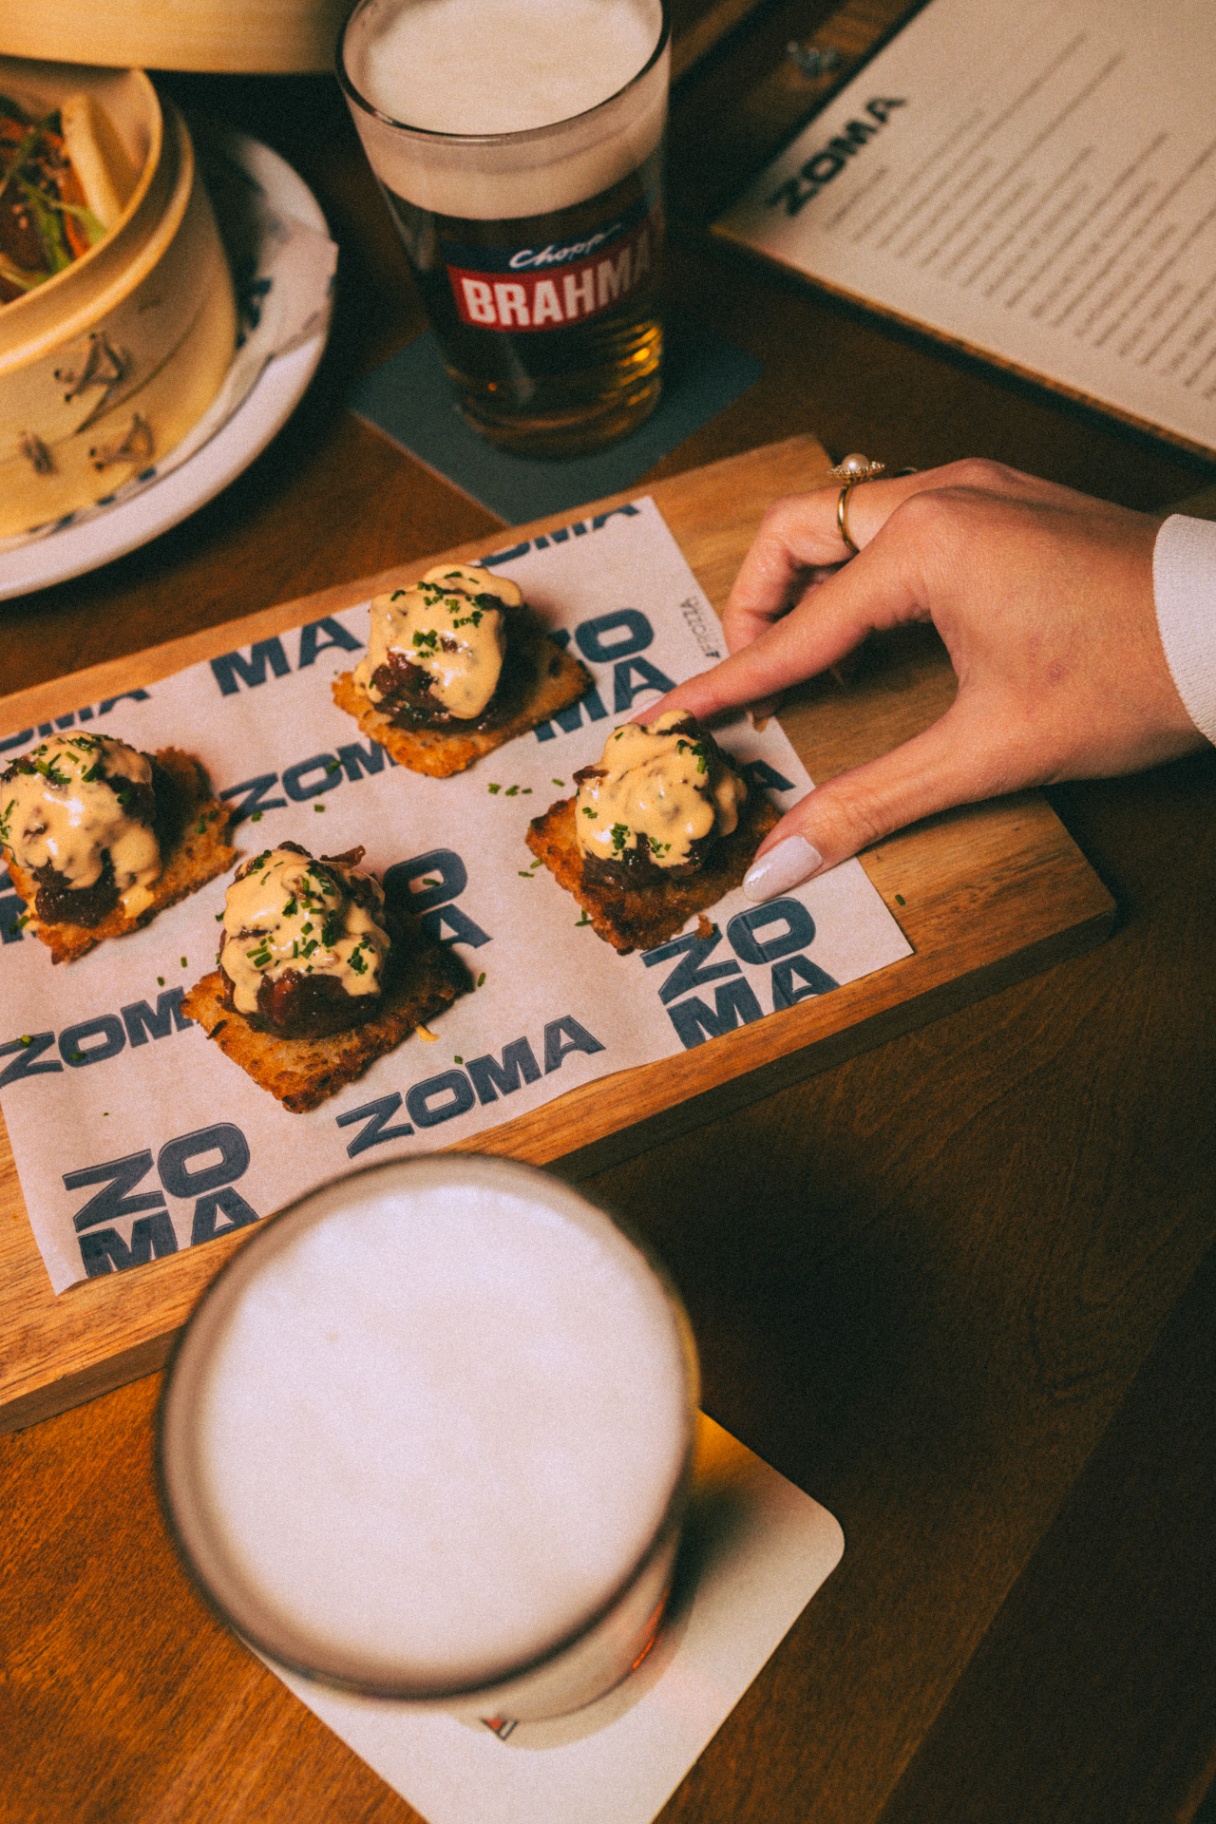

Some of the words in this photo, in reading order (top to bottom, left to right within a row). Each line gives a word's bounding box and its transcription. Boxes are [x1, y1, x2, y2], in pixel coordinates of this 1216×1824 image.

[768, 95, 907, 216] ZOMA
[461, 230, 651, 326] BRAHMA
[219, 738, 400, 829] ZOM
[640, 897, 816, 1005] ZO
[666, 954, 840, 1050] MA
[0, 986, 201, 1088] ZOM
[335, 1015, 606, 1159] ZOMA
[62, 1122, 251, 1234] ZO
[77, 1186, 261, 1279] MA
